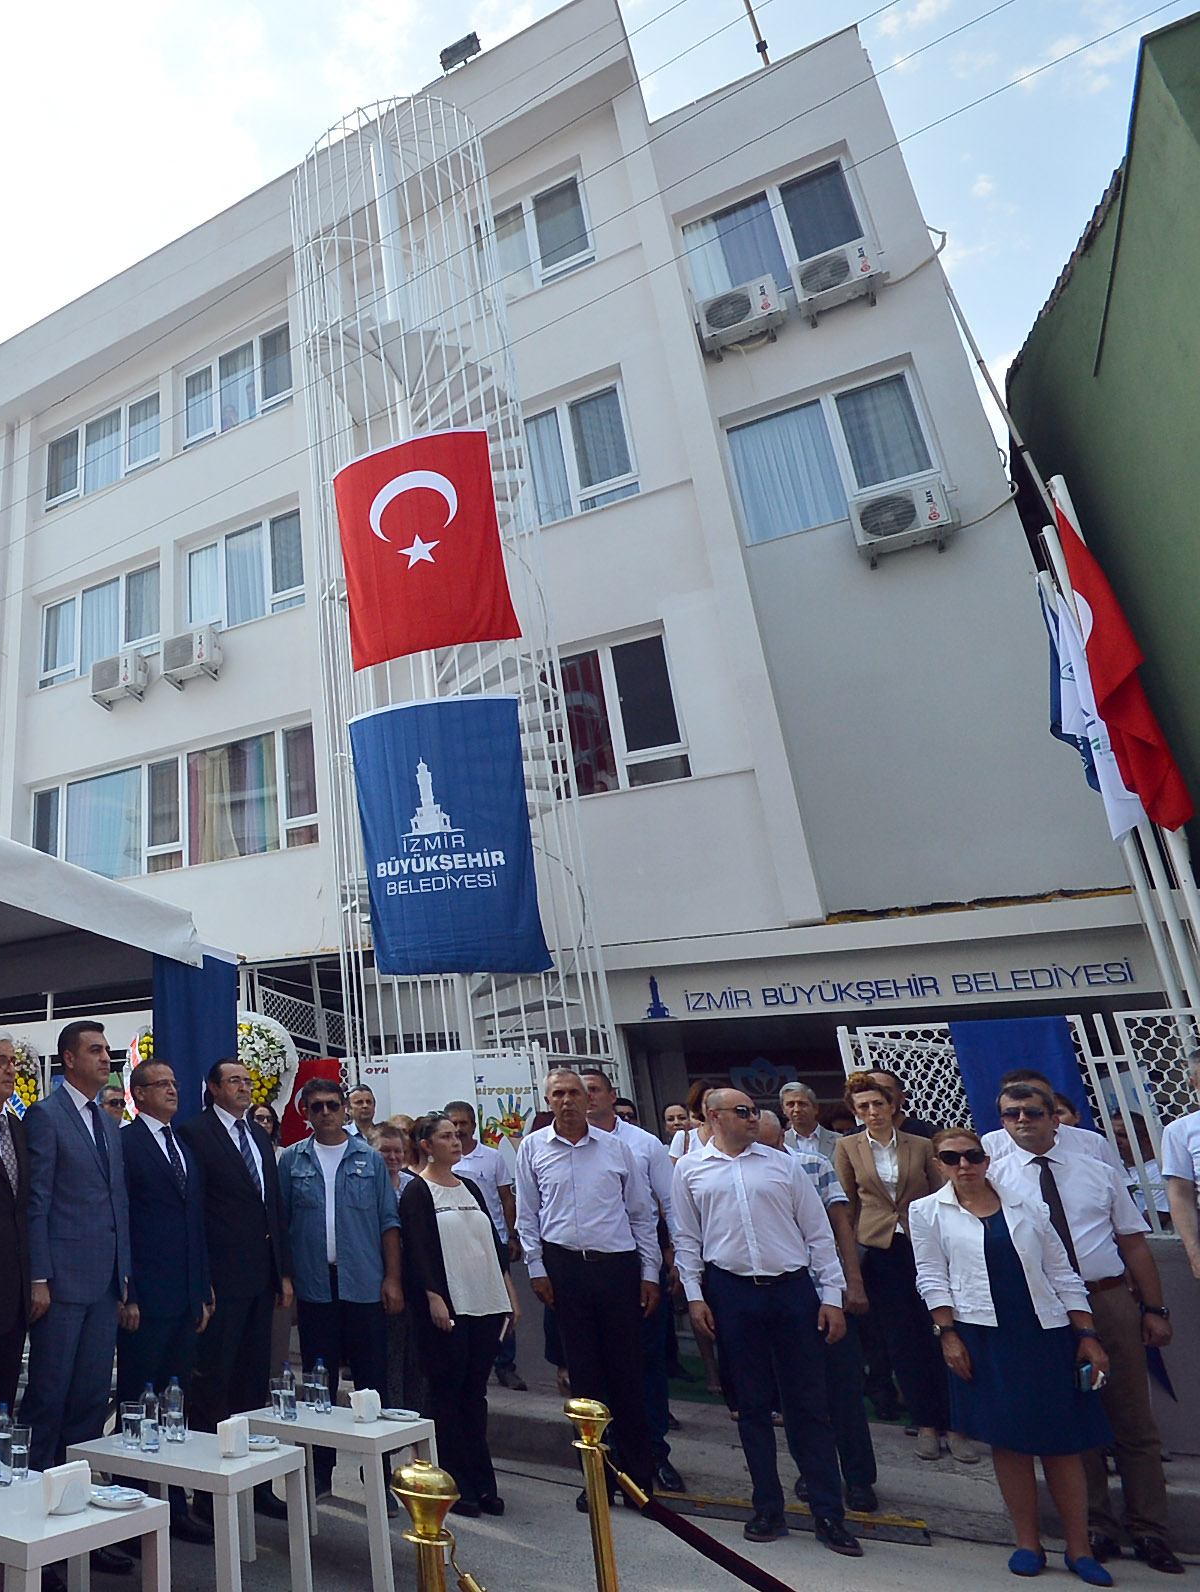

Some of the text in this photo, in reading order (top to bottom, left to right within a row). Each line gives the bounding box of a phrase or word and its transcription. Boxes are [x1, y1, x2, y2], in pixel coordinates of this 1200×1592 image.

[403, 832, 466, 853] İZMİR
[376, 847, 506, 878] BÜYÜKŞEHİR
[386, 869, 497, 896] BELEDİYESİ
[684, 957, 1136, 1012] İZMİR BÜYÜKŞEHİR BELEDİYESİ
